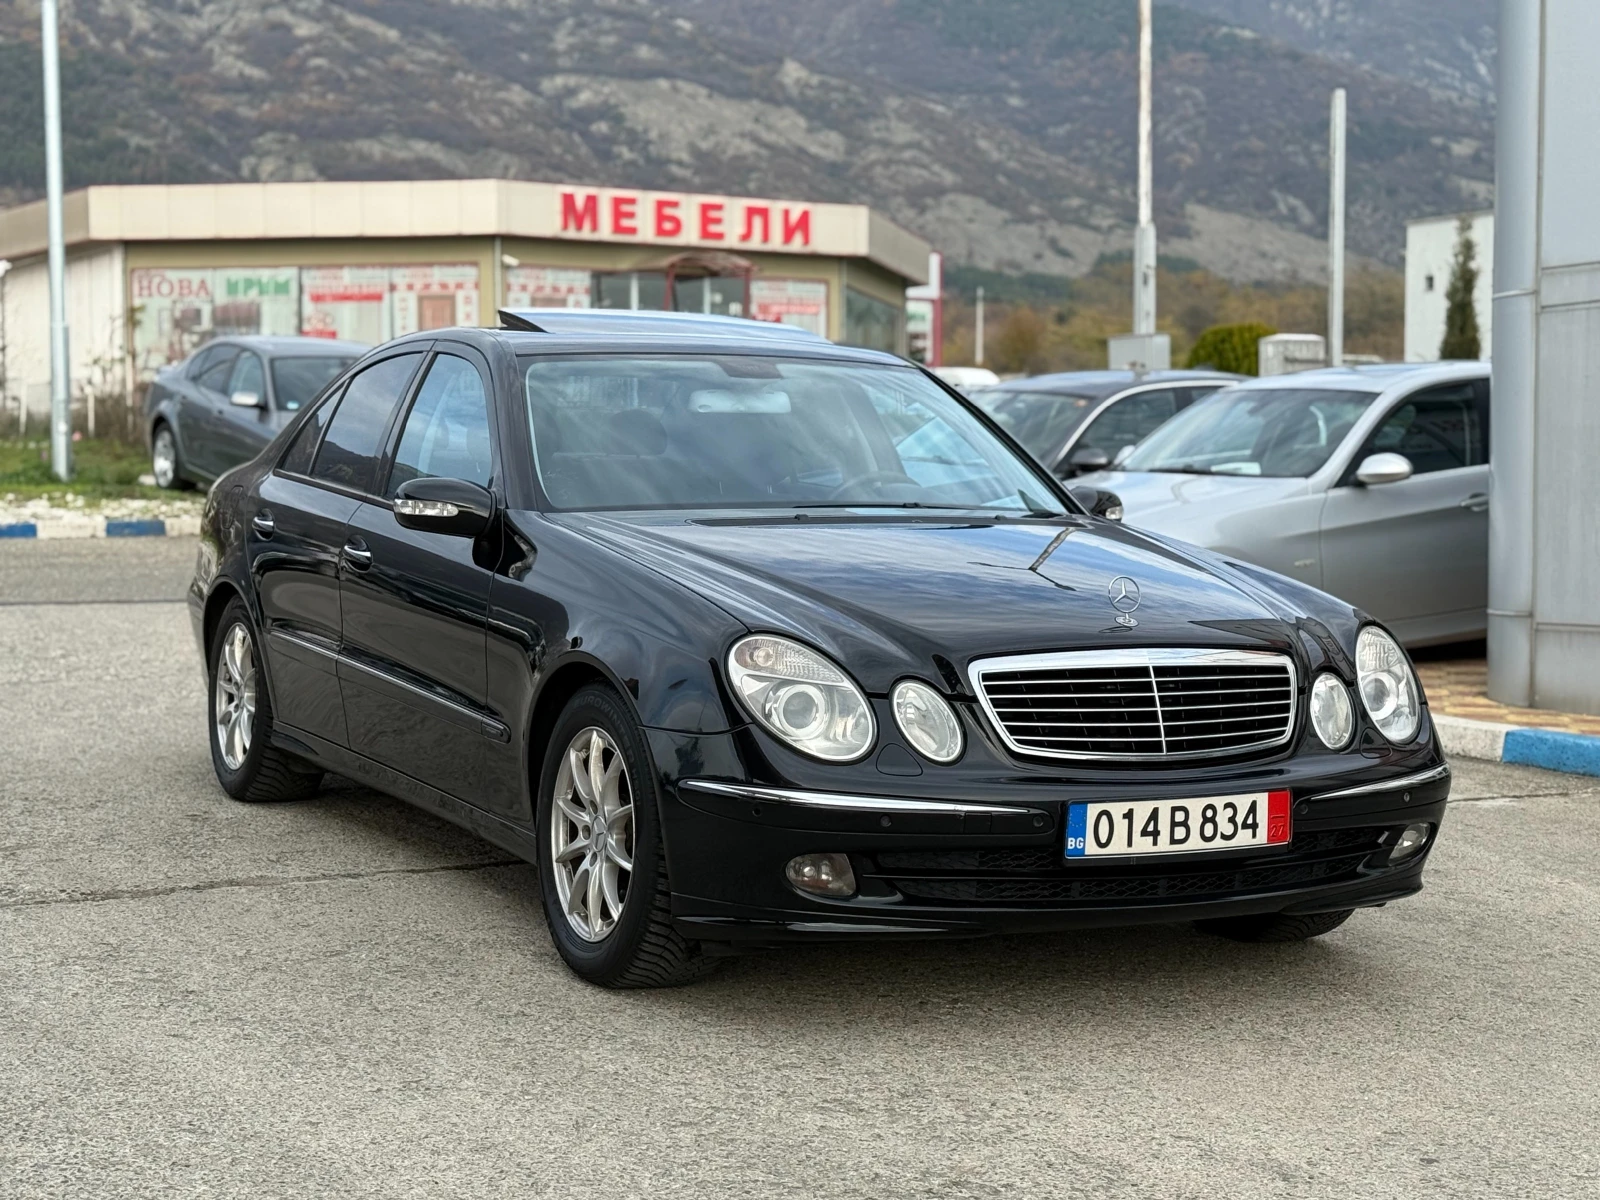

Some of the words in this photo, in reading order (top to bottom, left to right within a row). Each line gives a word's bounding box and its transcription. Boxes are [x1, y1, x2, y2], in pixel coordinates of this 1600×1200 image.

[560, 193, 812, 246] МЕБЕЛИ
[137, 277, 210, 298] НОВА
[1270, 823, 1285, 837] 27
[1067, 837, 1084, 850] BG
